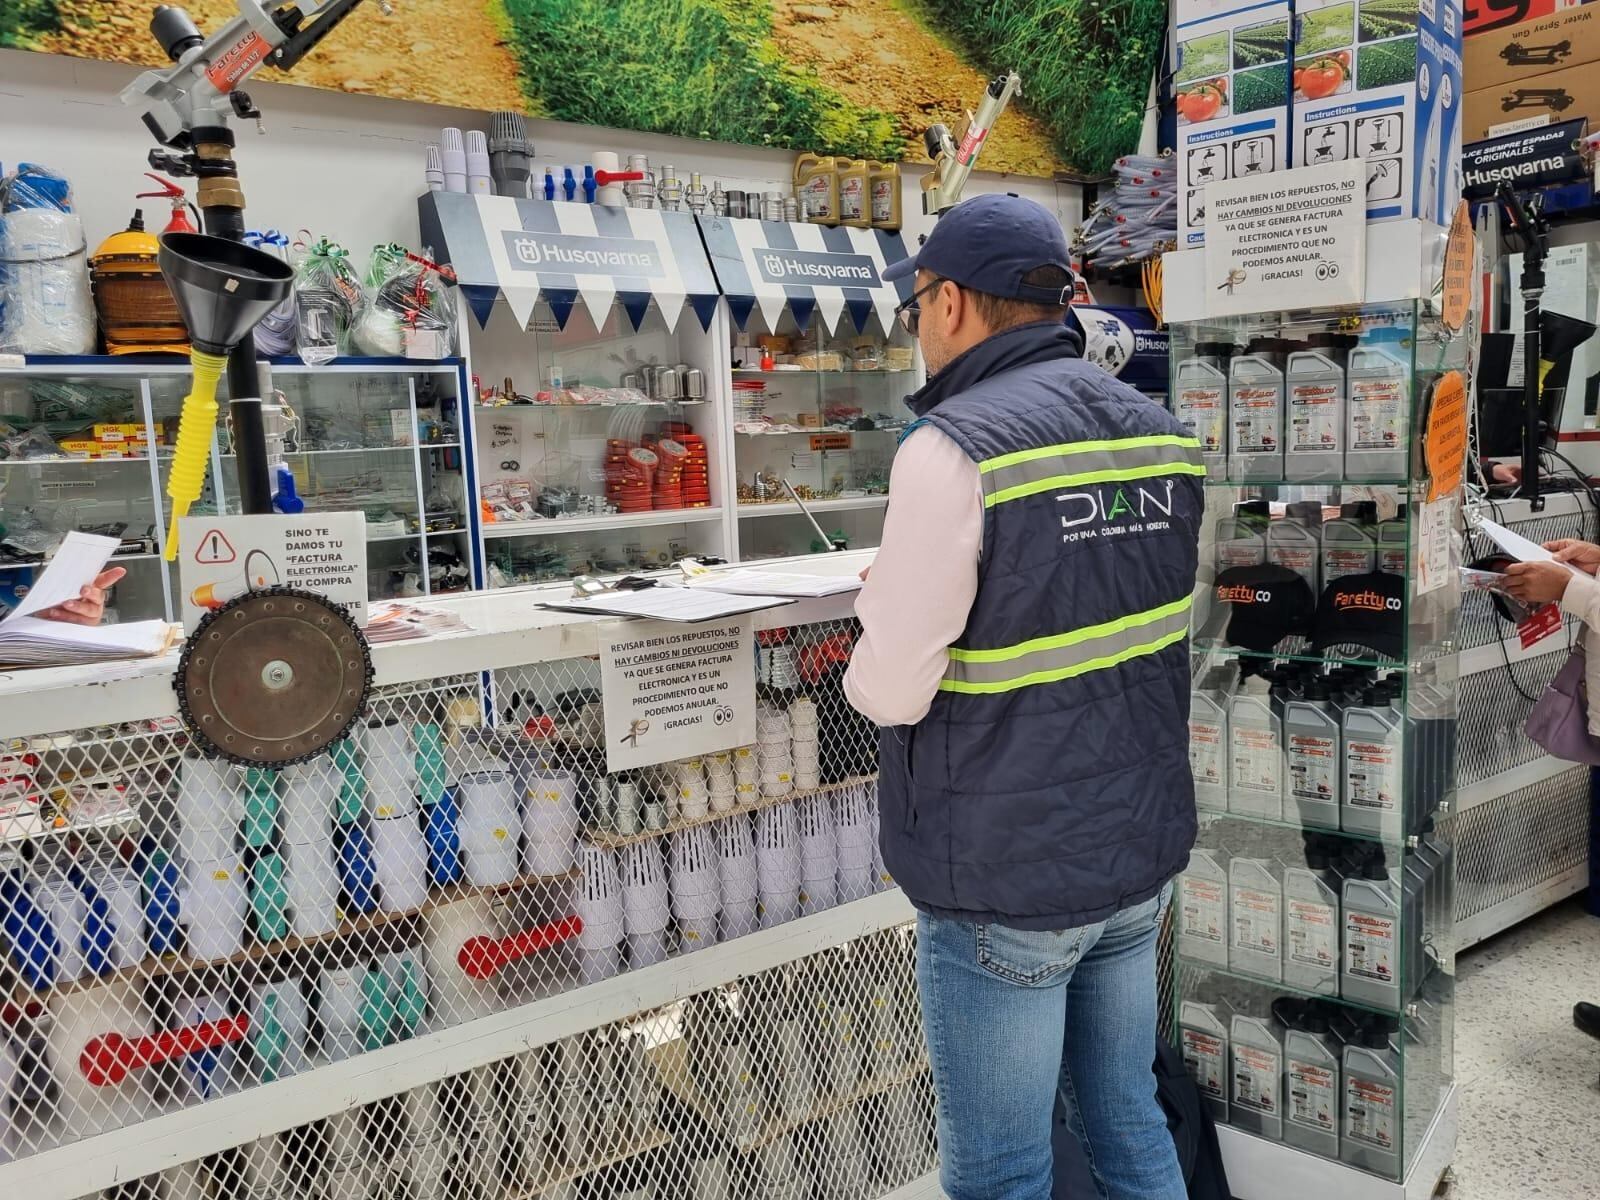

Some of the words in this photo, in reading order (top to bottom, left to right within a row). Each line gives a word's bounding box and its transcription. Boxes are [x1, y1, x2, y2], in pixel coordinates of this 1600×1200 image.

[1534, 20, 1559, 33] Spray
[1563, 12, 1592, 25] Water
[1512, 29, 1530, 39] Gun
[1307, 106, 1357, 121] Instructions
[1189, 129, 1233, 143] Instructions
[1484, 140, 1520, 154] SIEMPRE
[1522, 131, 1564, 146] ESPADAS
[1474, 145, 1534, 165] ORIGINALES
[1466, 155, 1565, 186] Husqvarna
[1216, 197, 1247, 207] REVISAR
[1250, 193, 1268, 203] BIEN
[1271, 191, 1285, 199] LOS
[1288, 183, 1339, 197] REPUESTOS,
[1341, 180, 1355, 188] NO
[1218, 211, 1233, 220] HAY
[1236, 205, 1273, 217] CAMBIOS
[1275, 204, 1284, 212] NI
[1286, 194, 1352, 210] DEVOLUCIONES
[1225, 223, 1236, 231] YA
[1238, 221, 1255, 230] QUE
[1257, 219, 1266, 227] SE
[1268, 215, 1301, 226] GENERA
[1303, 209, 1343, 221] FACTURA
[1239, 230, 1293, 243] ELECTRONICA
[1303, 226, 1312, 234] ES
[1314, 225, 1328, 233] UN
[542, 244, 652, 267] Husqvarna
[1232, 241, 1299, 256] PROCEDIMIENTO
[1301, 239, 1319, 248] QUE
[785, 259, 872, 279] Husqvarna
[1243, 256, 1284, 268] PODEMOS
[1286, 252, 1323, 263] ANULAR.
[1262, 269, 1303, 281] ¡GRACIAS!
[285, 529, 312, 537] SINO
[1063, 533, 1078, 543] POR
[1080, 530, 1097, 540] UNA
[286, 542, 325, 550] DAMOS
[306, 577, 352, 586] COMPRA
[1217, 585, 1271, 603] Faretty.co
[1335, 590, 1401, 611] Faretty.co
[611, 641, 644, 652] REVISAR
[646, 638, 664, 646] BIEN
[666, 636, 680, 644] LOS
[682, 629, 727, 642] REPUESTOS,
[728, 627, 740, 635] NO
[614, 658, 632, 667] HAY
[633, 651, 670, 664] CAMBIOS
[672, 649, 680, 657] NI
[682, 640, 739, 655] DEVOLUCIONES
[624, 670, 634, 679] YA
[636, 668, 654, 677] QUE
[655, 666, 664, 674] SE
[666, 660, 696, 672] GENERA
[698, 655, 732, 666] FACTURA
[639, 676, 690, 690] ELECTRONICA
[698, 672, 707, 680] ES
[709, 670, 720, 678] UN
[632, 688, 696, 706] PROCEDIMIENTO
[698, 685, 714, 694] QUE
[716, 682, 728, 690] NO
[644, 704, 684, 717] PODEMOS
[686, 698, 719, 710] ANULAR.
[664, 715, 702, 730] ¡GRACIAS!
